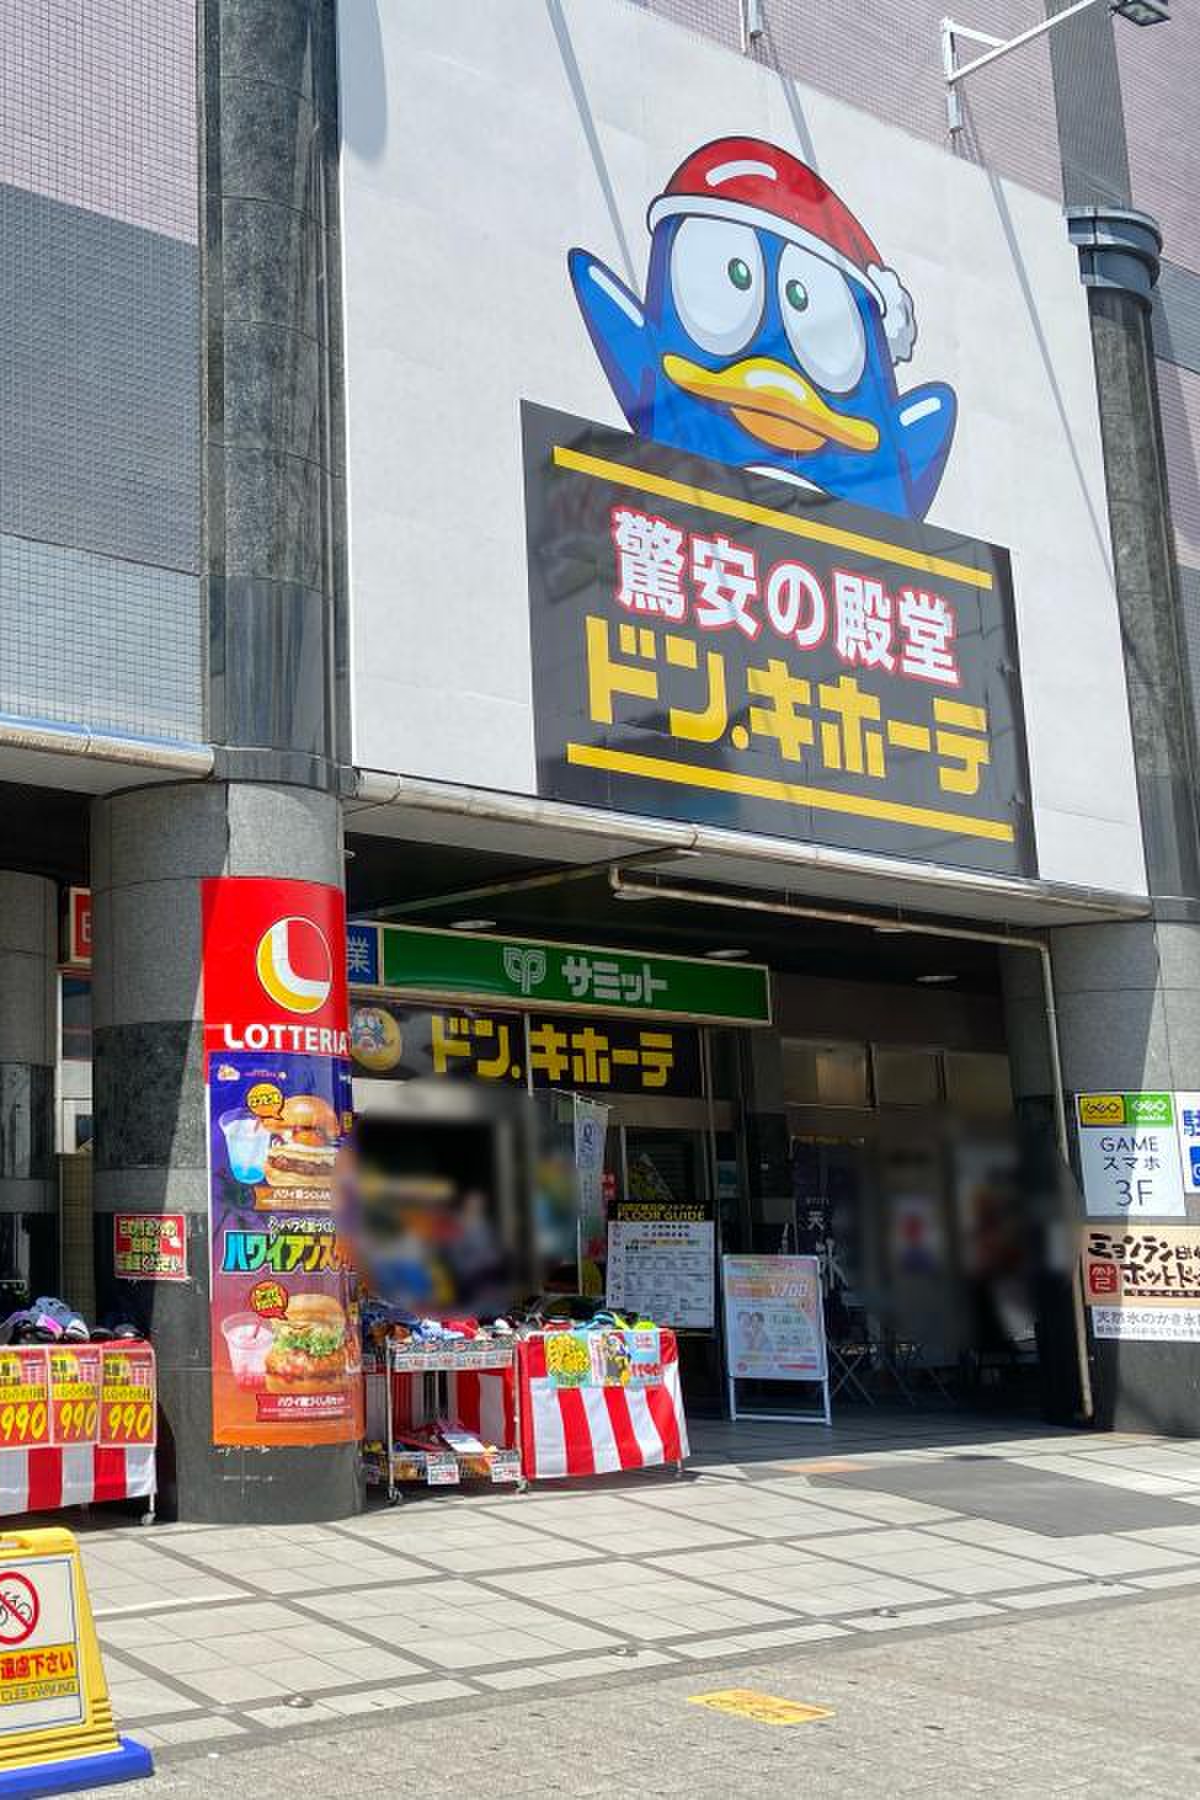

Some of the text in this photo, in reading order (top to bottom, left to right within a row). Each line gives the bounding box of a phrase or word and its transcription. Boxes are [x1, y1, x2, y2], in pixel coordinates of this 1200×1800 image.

[610, 504, 960, 688] 驚安の殿堂
[560, 955, 668, 1004] サミット
[223, 1022, 351, 1055] LOTTERIA
[1101, 1135, 1159, 1152] GAME
[1103, 1155, 1161, 1171] スマホ
[1115, 1179, 1153, 1207] 3F
[223, 1232, 354, 1273] ハワイアンス
[0, 1401, 49, 1441] 990
[59, 1401, 98, 1438] 990
[107, 1402, 152, 1440] 990
[31, 1680, 76, 1700] PARKING
